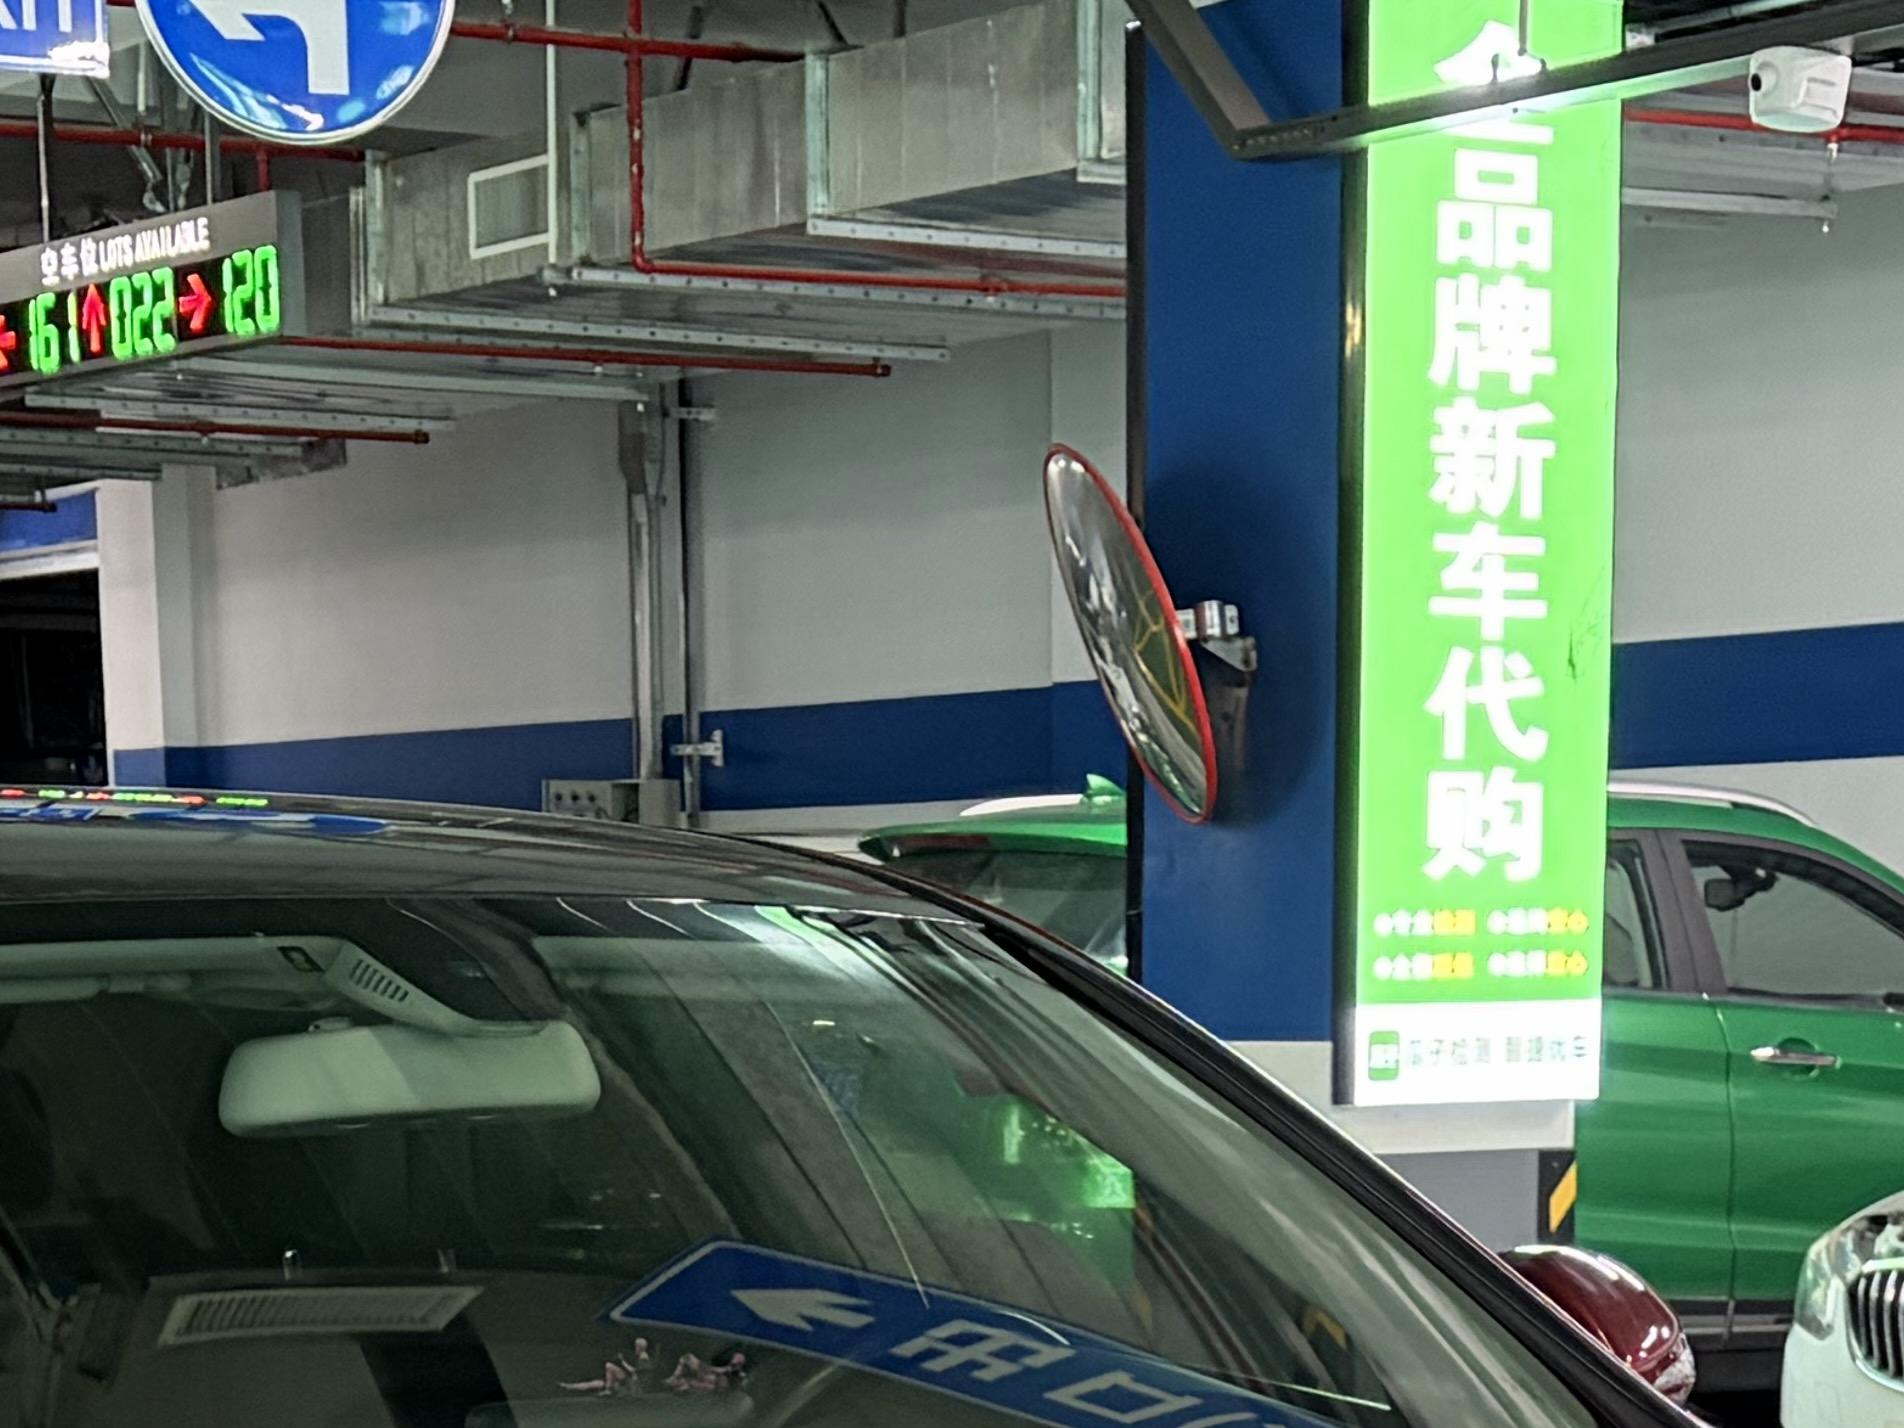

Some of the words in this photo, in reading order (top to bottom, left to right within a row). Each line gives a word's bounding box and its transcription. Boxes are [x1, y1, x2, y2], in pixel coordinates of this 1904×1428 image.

[99, 234, 134, 274] LOTS
[135, 216, 210, 264] AVAILABLE
[29, 291, 81, 374] 161
[109, 266, 176, 361] 022
[222, 244, 281, 336] 120
